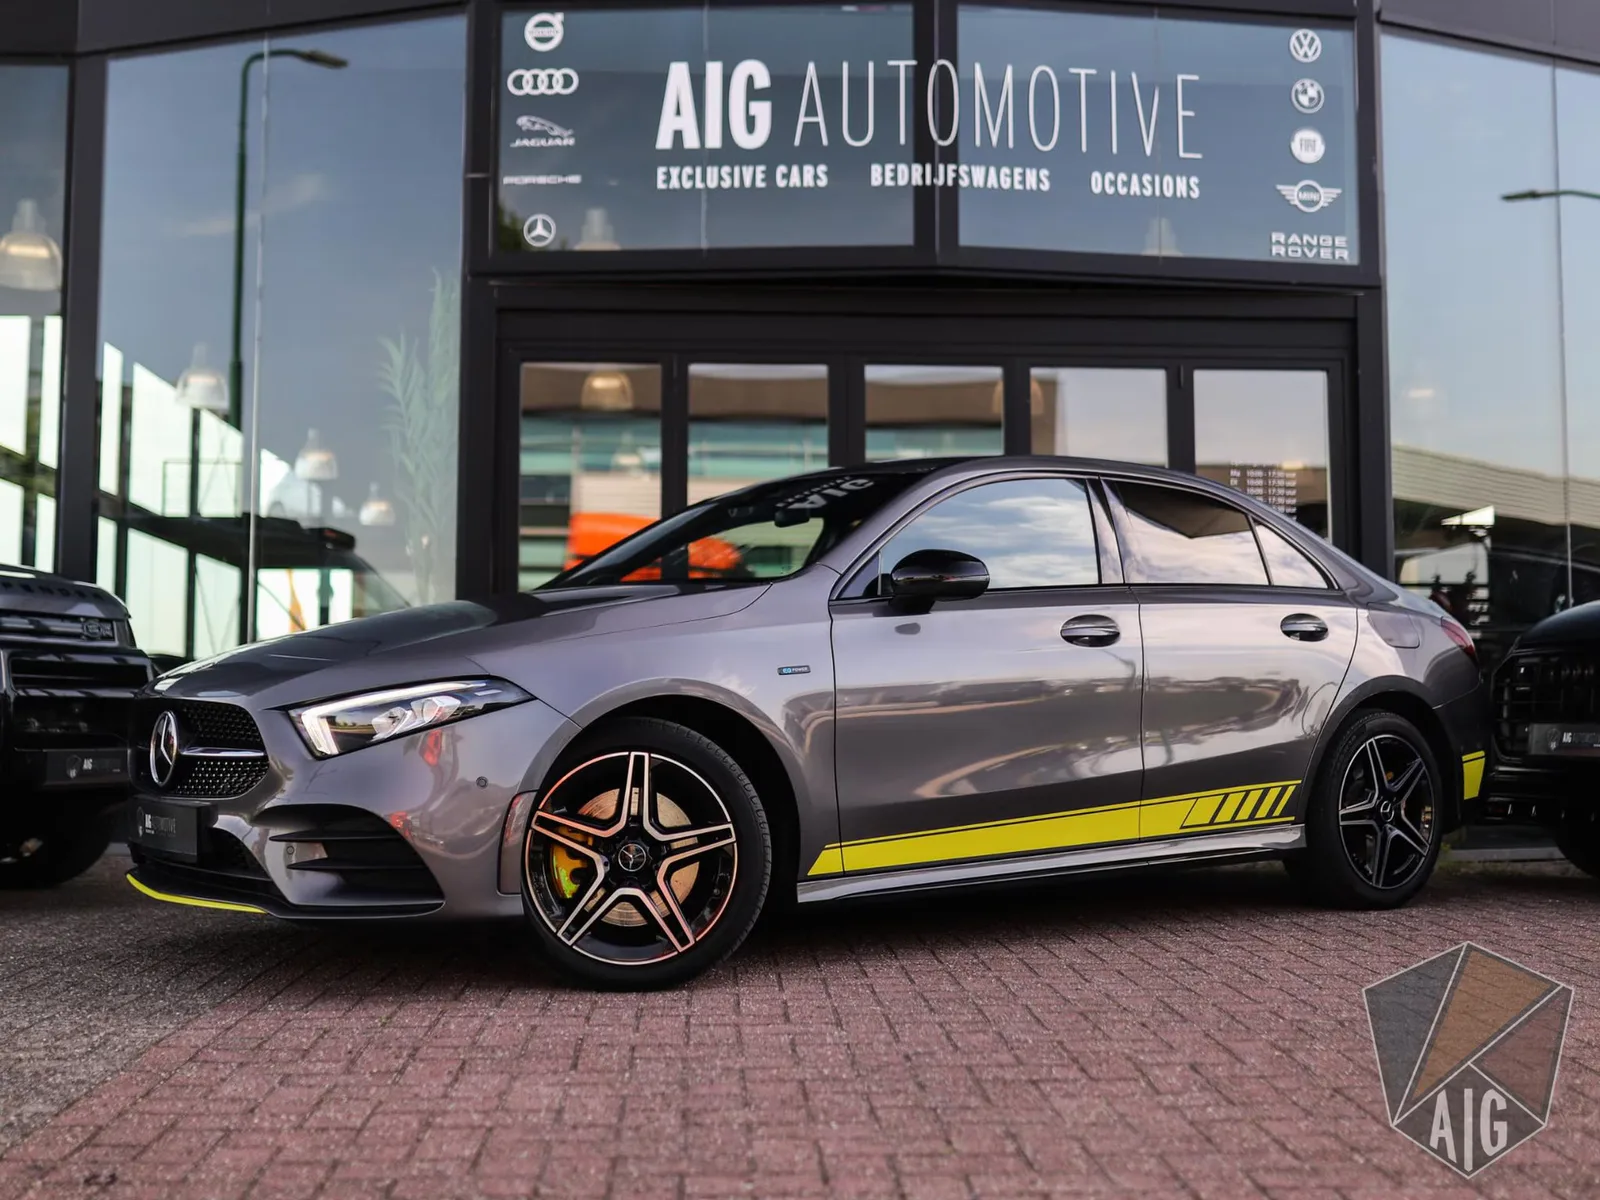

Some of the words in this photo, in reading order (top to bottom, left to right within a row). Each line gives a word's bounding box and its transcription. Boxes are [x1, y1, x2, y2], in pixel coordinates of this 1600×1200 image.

[655, 59, 772, 150] AIG
[793, 58, 1203, 159] AUTOMOTIVE
[510, 137, 576, 148] JAGUAR
[656, 164, 767, 190] EXCLUSIVE
[776, 163, 829, 188] CARS
[870, 162, 1051, 192] BEDRIJFSWAGENS
[1091, 170, 1200, 199] OCCASIONS
[1298, 191, 1321, 202] MINI
[1271, 231, 1347, 248] RANGE
[1271, 244, 1349, 261] ROVER
